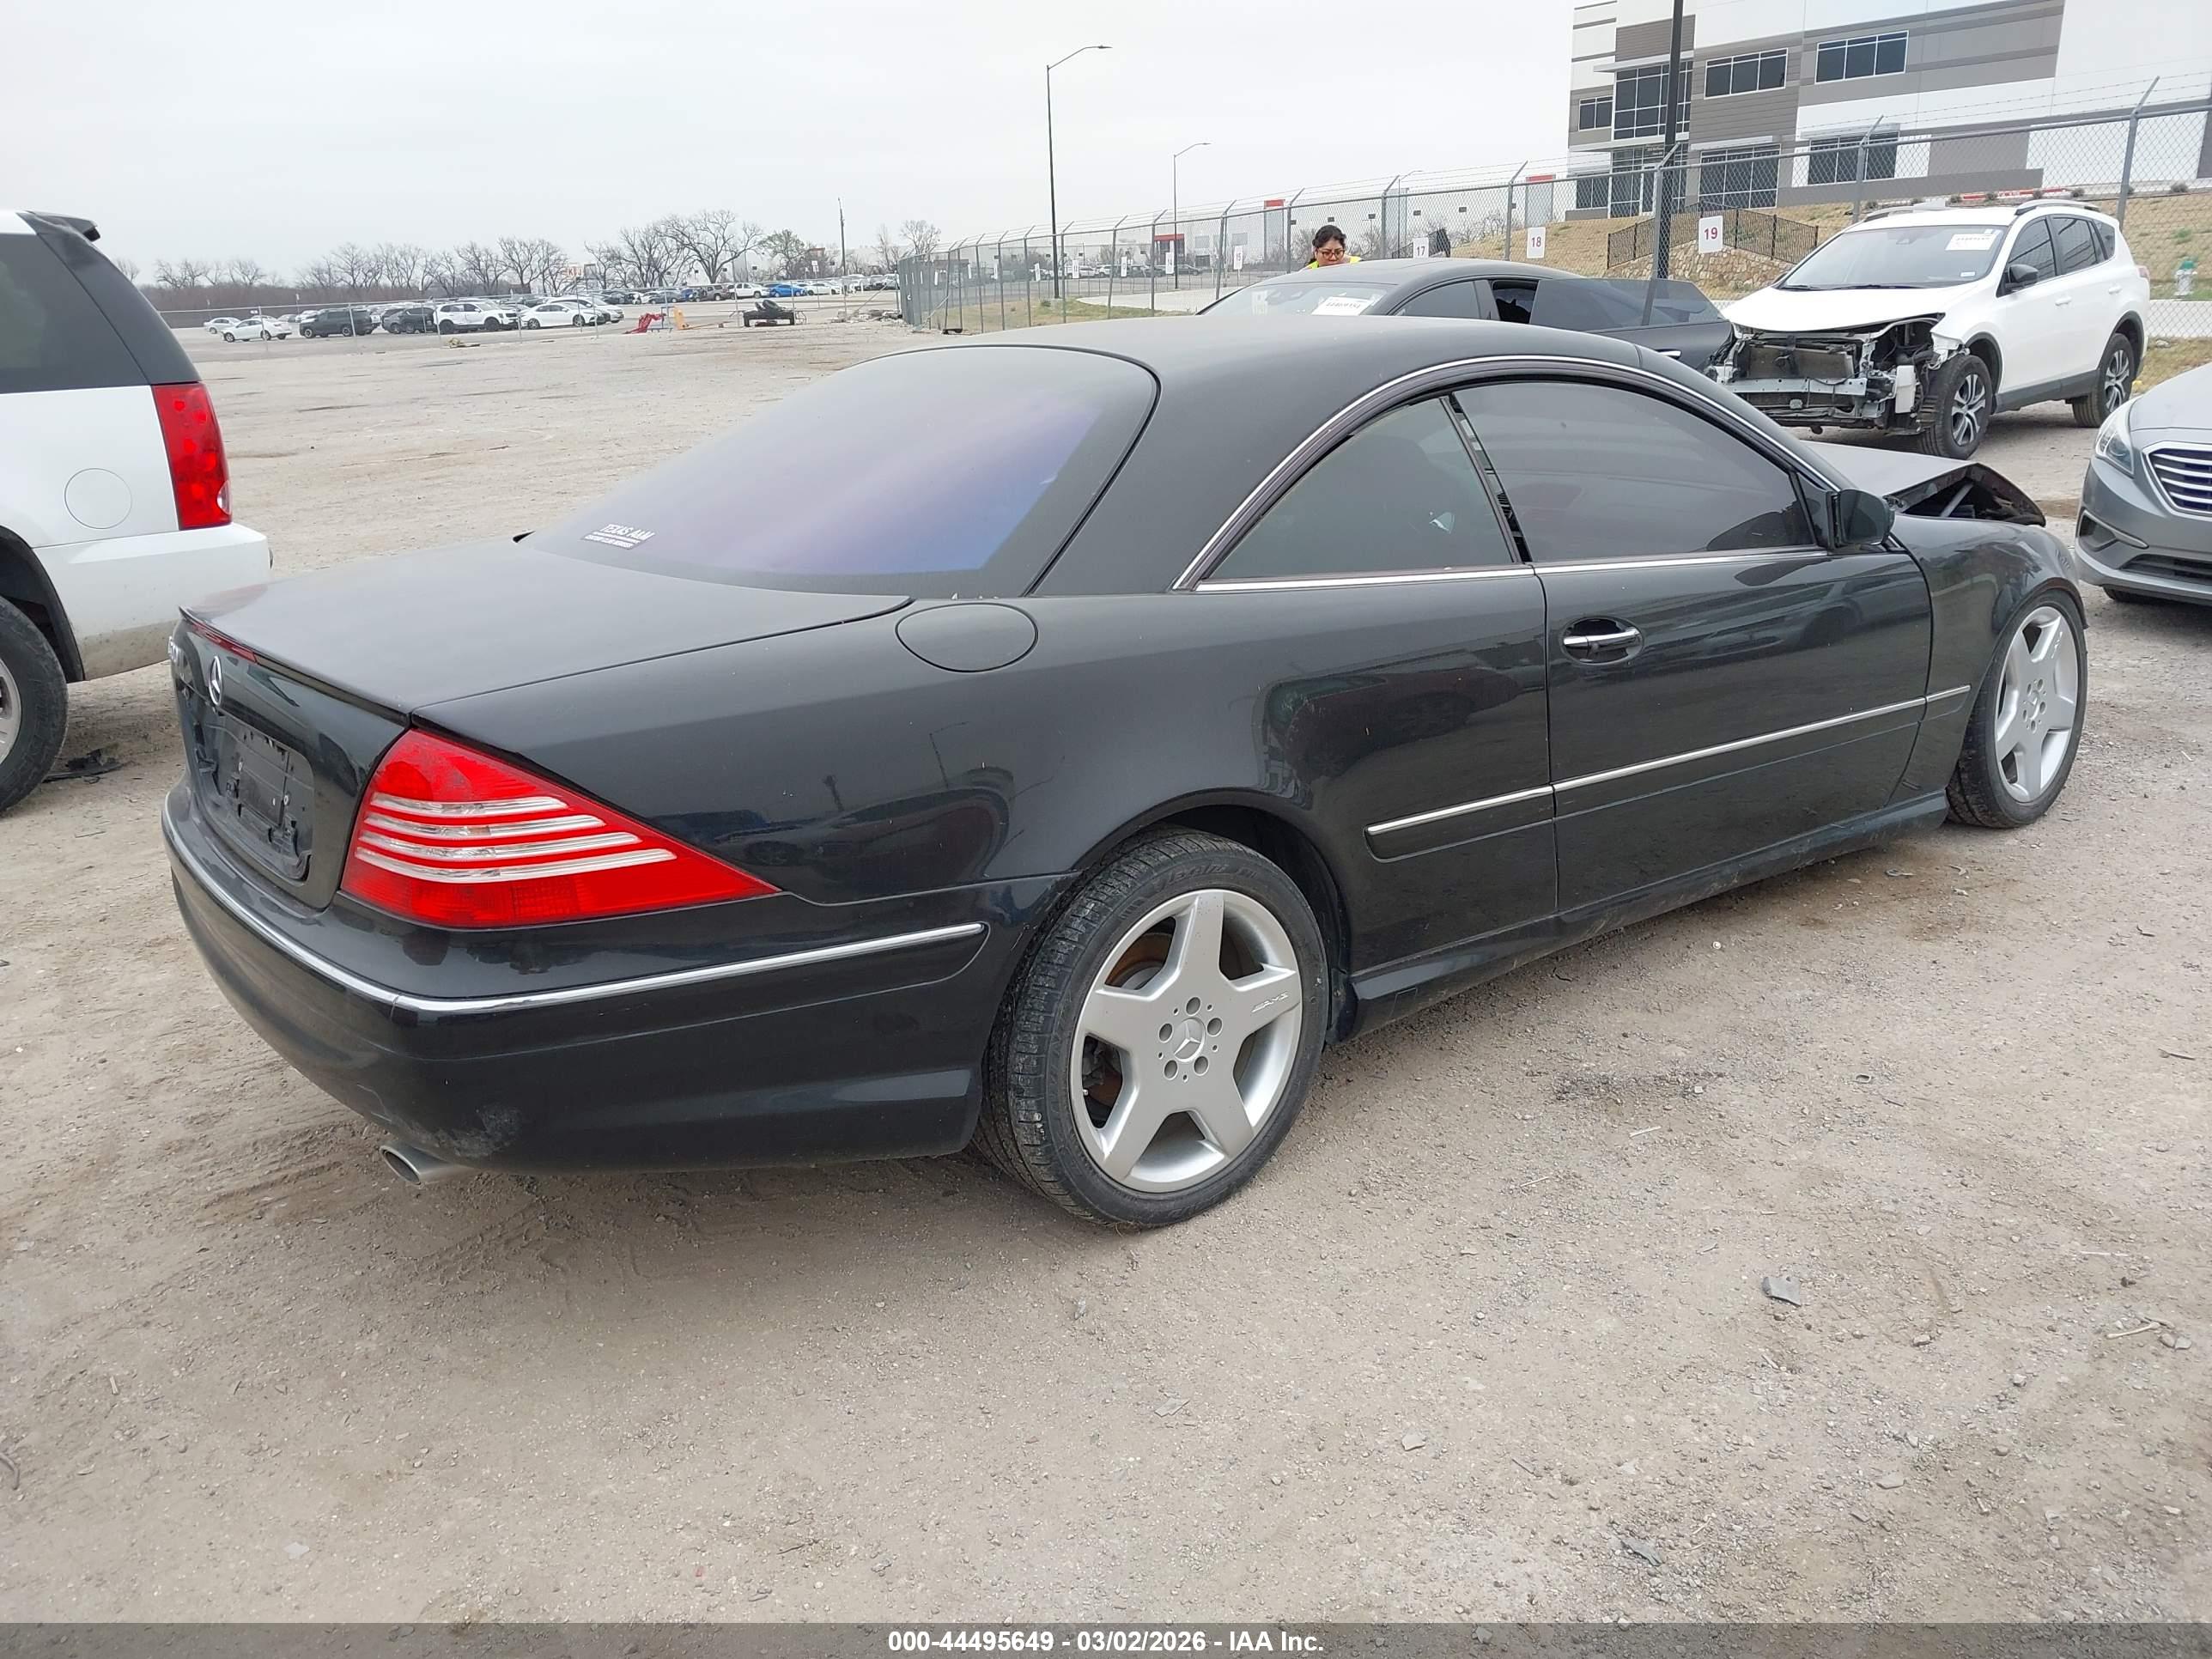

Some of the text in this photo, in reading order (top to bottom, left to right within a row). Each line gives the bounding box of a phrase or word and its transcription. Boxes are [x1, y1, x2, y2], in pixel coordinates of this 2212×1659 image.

[1704, 227, 1718, 240] 19
[1531, 236, 1541, 248] 18
[1416, 246, 1425, 257] 17
